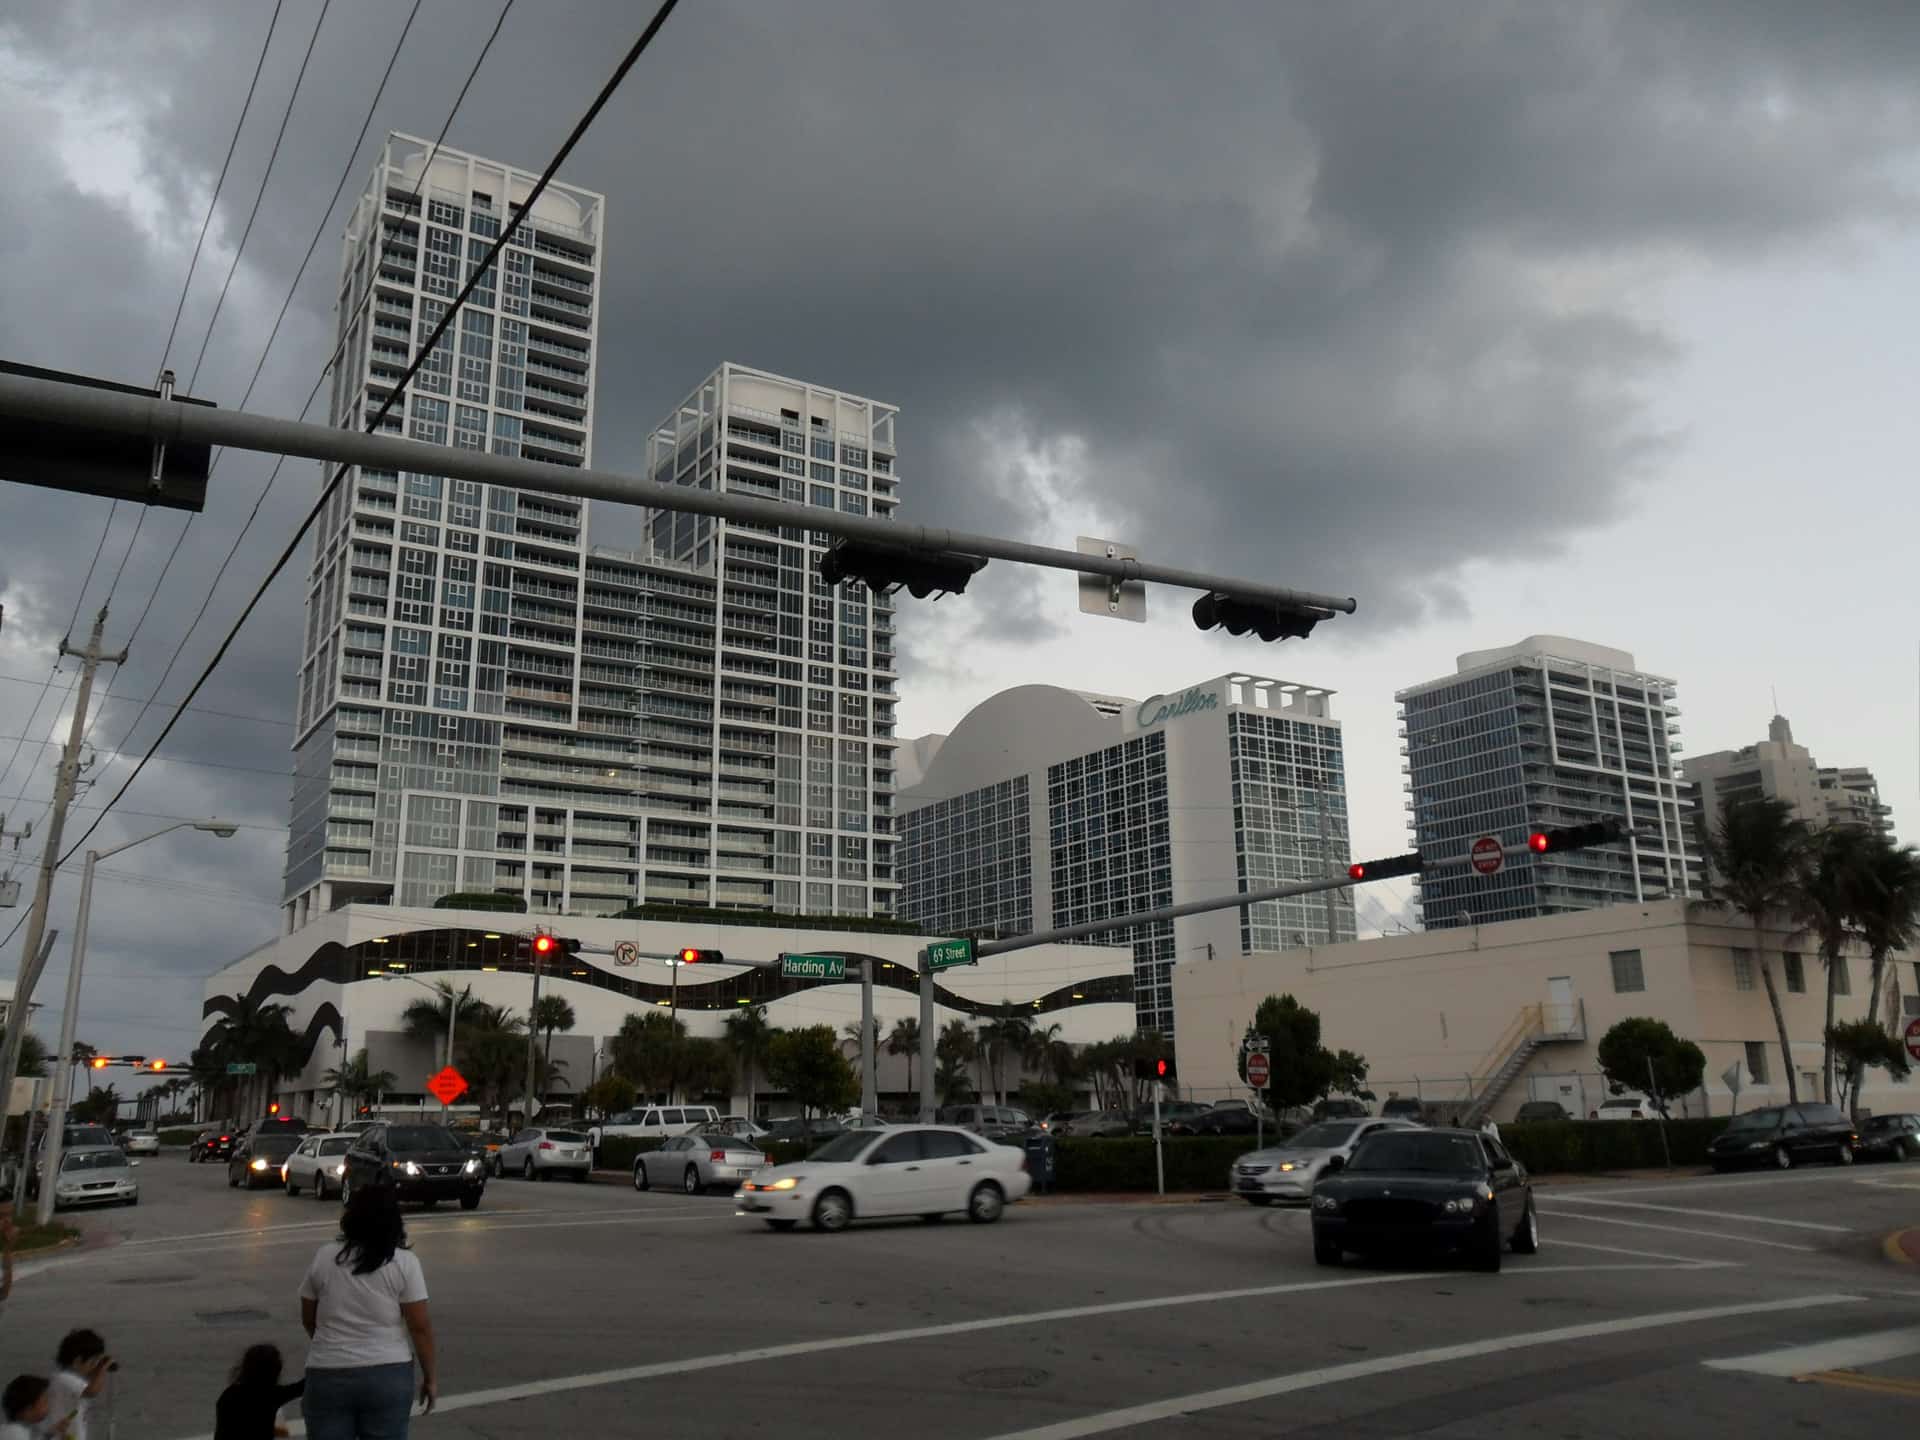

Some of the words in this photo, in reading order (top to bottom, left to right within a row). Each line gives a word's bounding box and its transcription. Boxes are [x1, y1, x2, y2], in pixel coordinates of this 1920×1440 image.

[933, 950, 943, 963] 69
[945, 947, 966, 960] Street
[784, 959, 825, 977] Harding
[829, 961, 842, 975] Av
